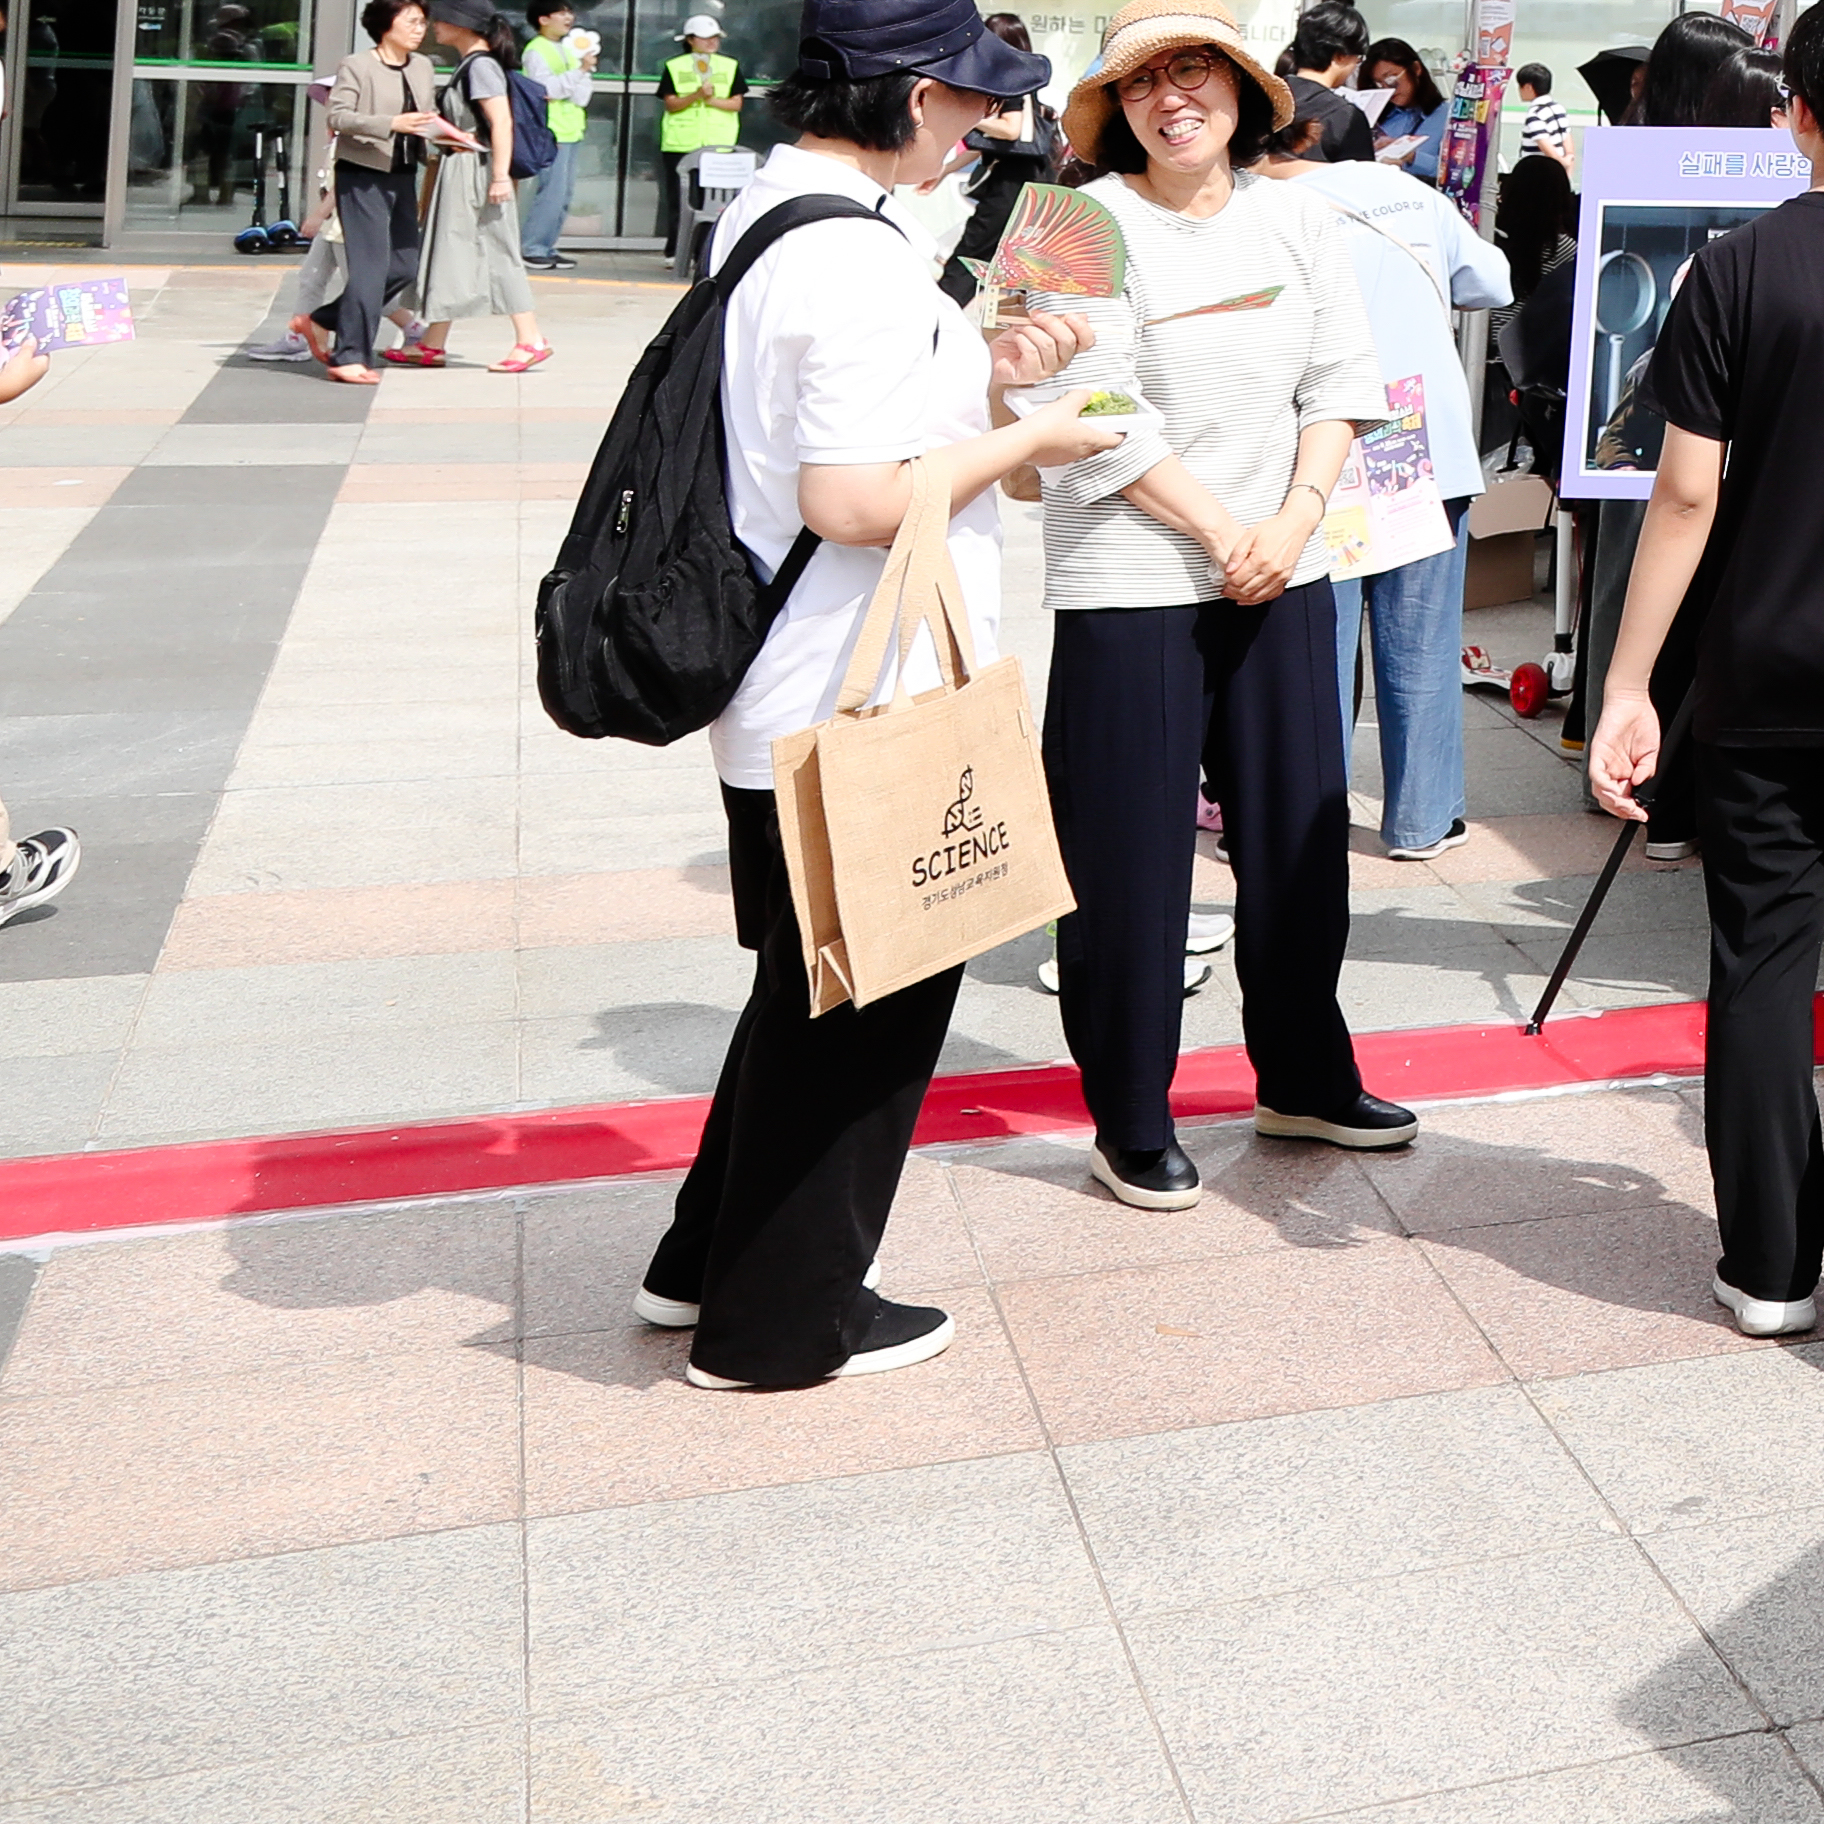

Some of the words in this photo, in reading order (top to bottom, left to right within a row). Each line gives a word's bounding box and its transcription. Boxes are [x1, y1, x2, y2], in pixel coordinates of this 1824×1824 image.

[1031, 15, 1084, 34] 원하는
[1681, 153, 1745, 176] 실패를
[1372, 201, 1410, 217] COLOR
[1412, 201, 1425, 211] OF
[912, 821, 1010, 887] SCIENCE
[921, 862, 1009, 911] 경기도성남교육지원청
